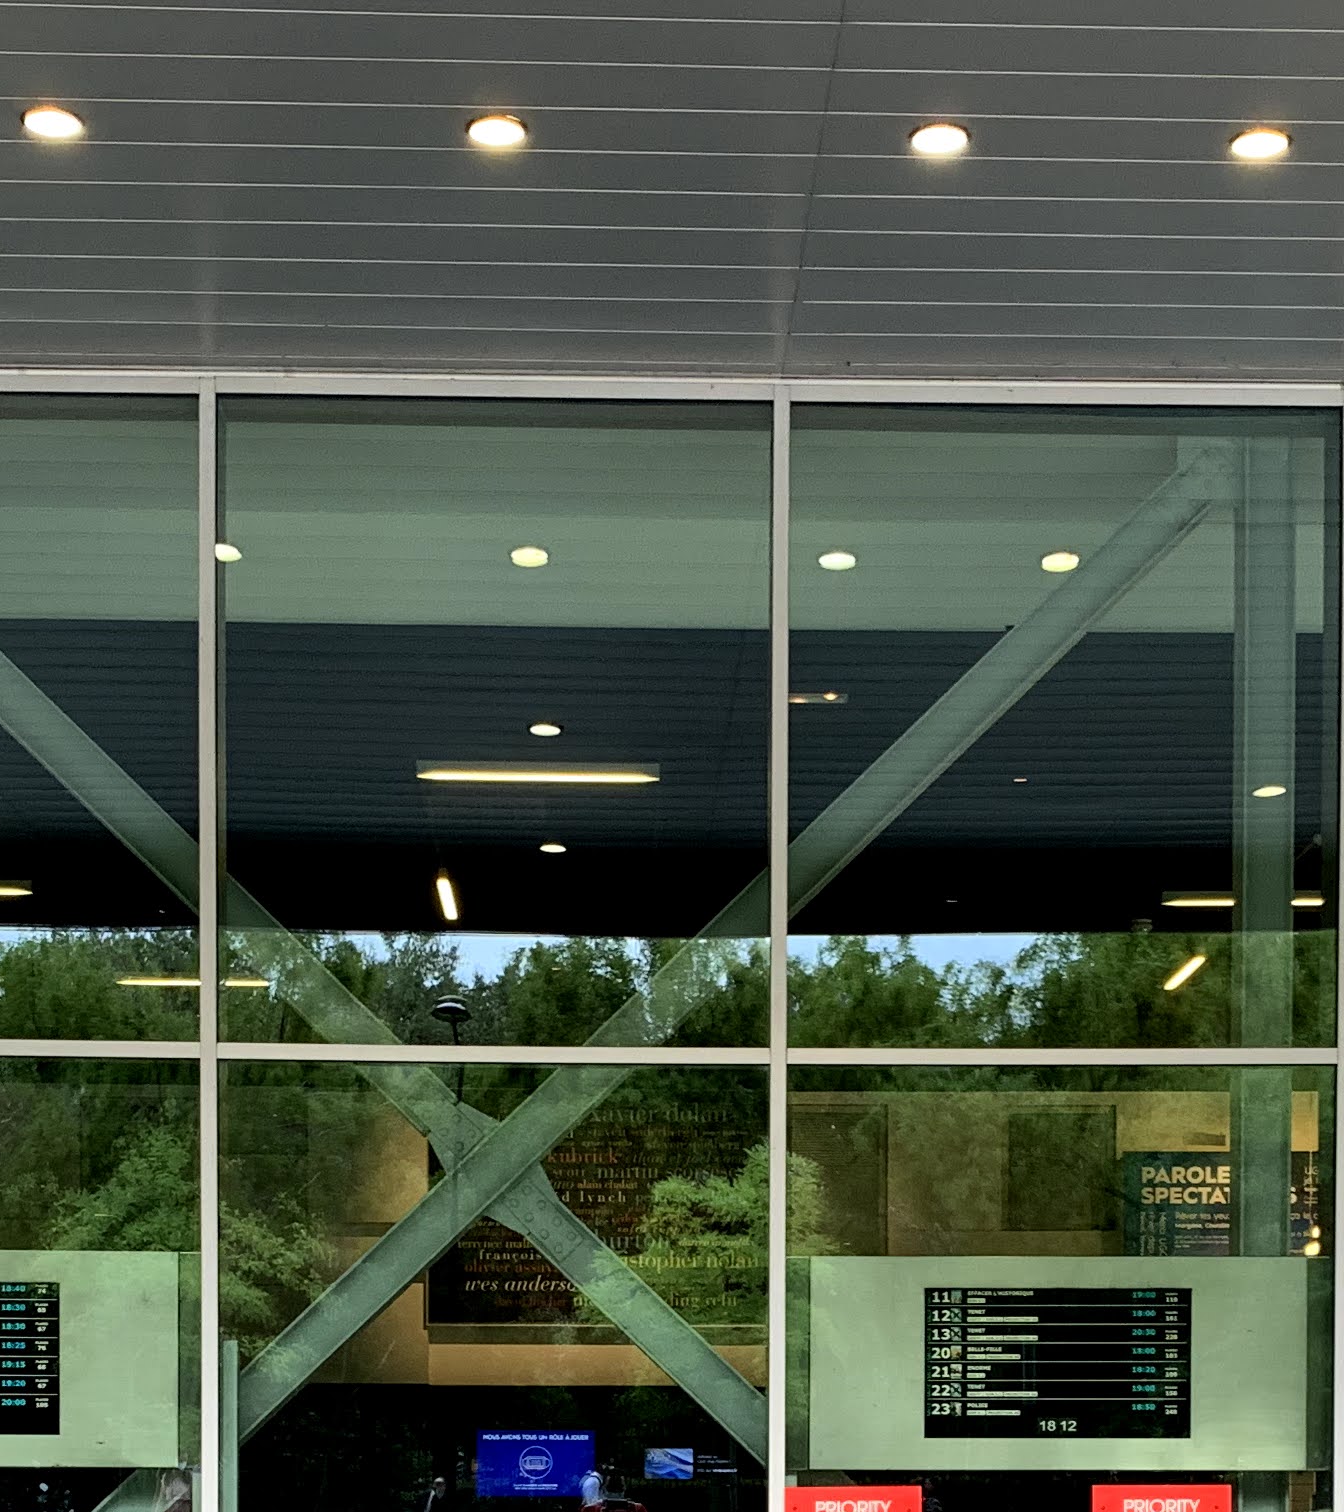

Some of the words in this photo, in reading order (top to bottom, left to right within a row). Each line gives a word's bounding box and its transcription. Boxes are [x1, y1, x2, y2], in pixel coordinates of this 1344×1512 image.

[1141, 1165, 1231, 1184] PAROLE
[465, 1279, 498, 1292] wes
[1039, 1420, 1056, 1432] 18
[1060, 1420, 1077, 1432] 12
